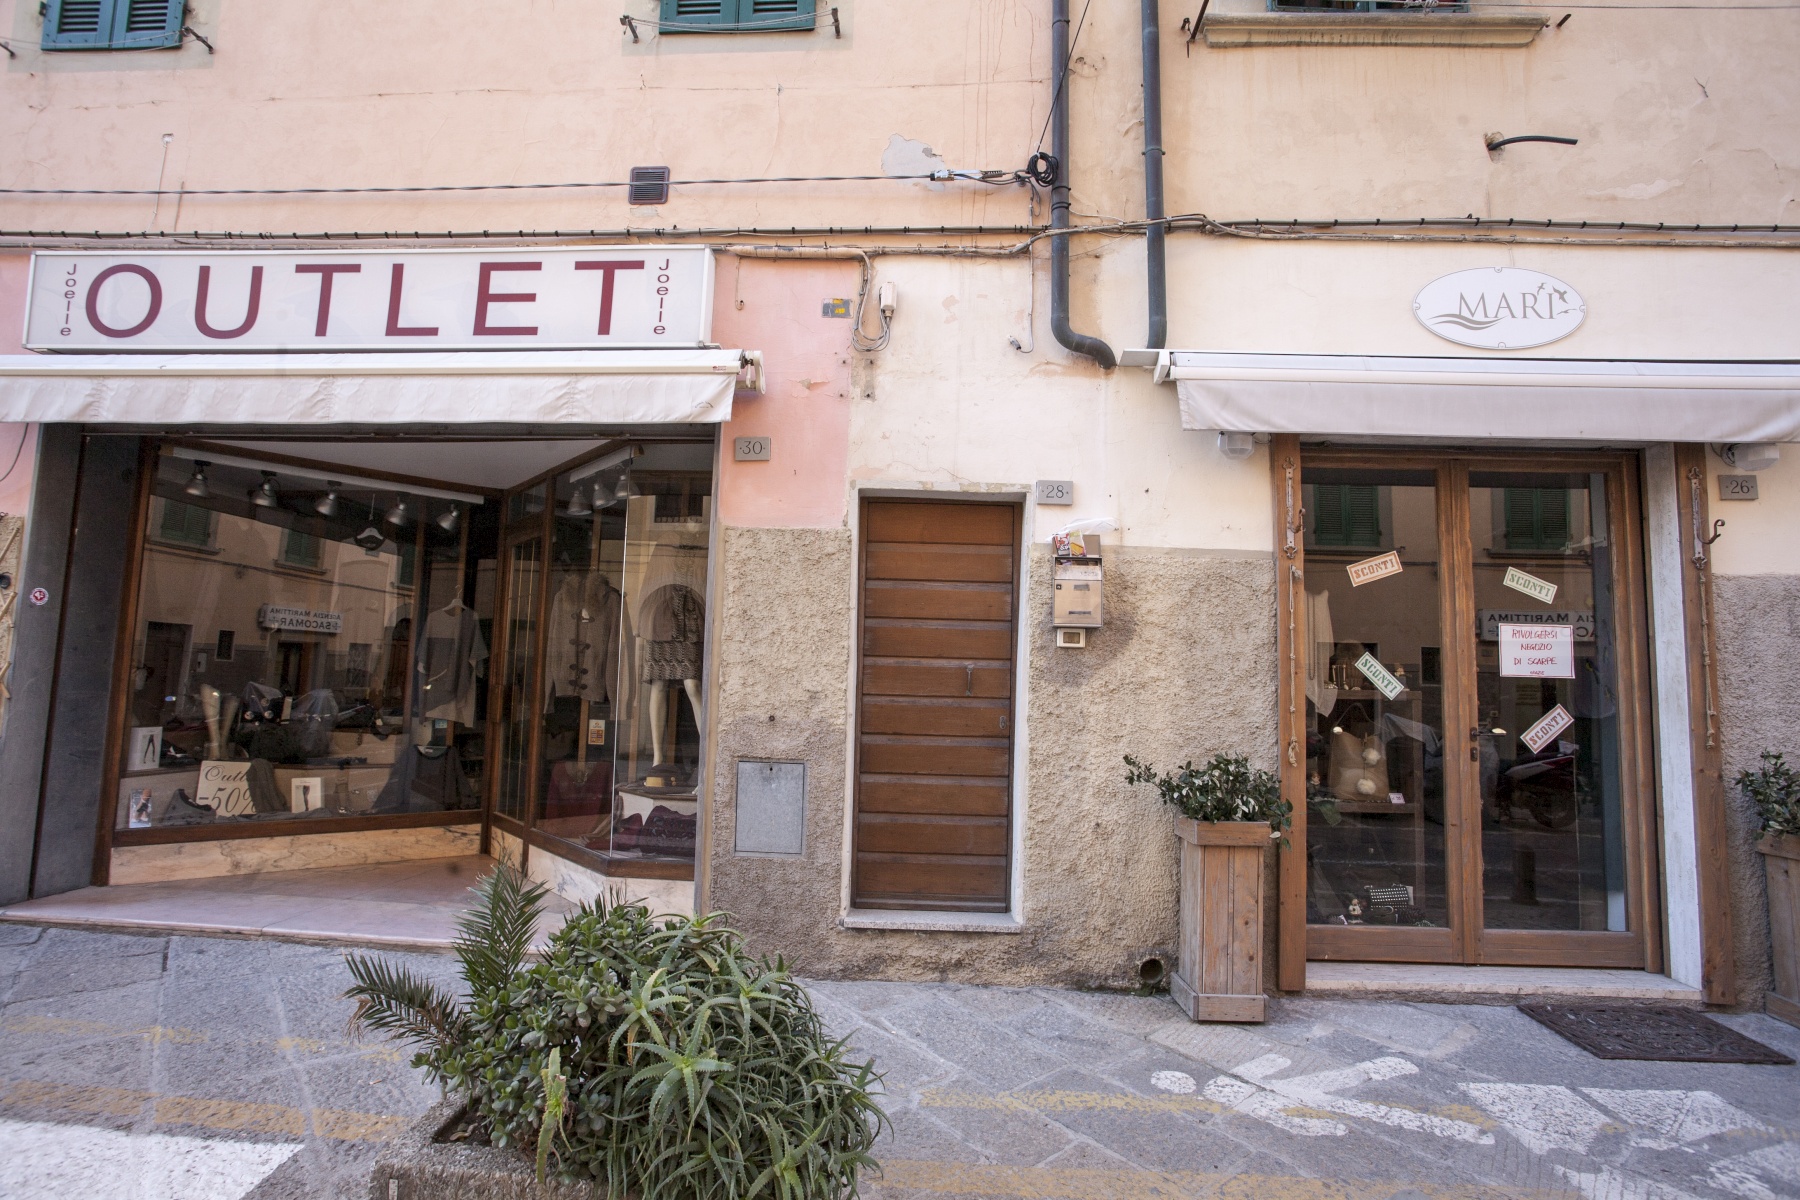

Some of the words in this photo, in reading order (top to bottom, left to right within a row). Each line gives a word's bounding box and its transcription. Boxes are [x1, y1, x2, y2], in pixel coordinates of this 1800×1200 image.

[60, 263, 77, 336] Joelle
[85, 260, 645, 339] OUTLET
[653, 258, 670, 335] Joelle
[1458, 291, 1557, 320] MARI
[1353, 558, 1396, 580] SCONTI
[1508, 573, 1552, 598] SCONTI
[1511, 628, 1558, 639] RIVOLGERSI
[1520, 643, 1553, 651] NEGOZIO
[1513, 657, 1522, 666] DI
[1527, 656, 1558, 666] SCARPE
[1361, 658, 1398, 694] SCONTI
[1528, 711, 1566, 746] SCONTI
